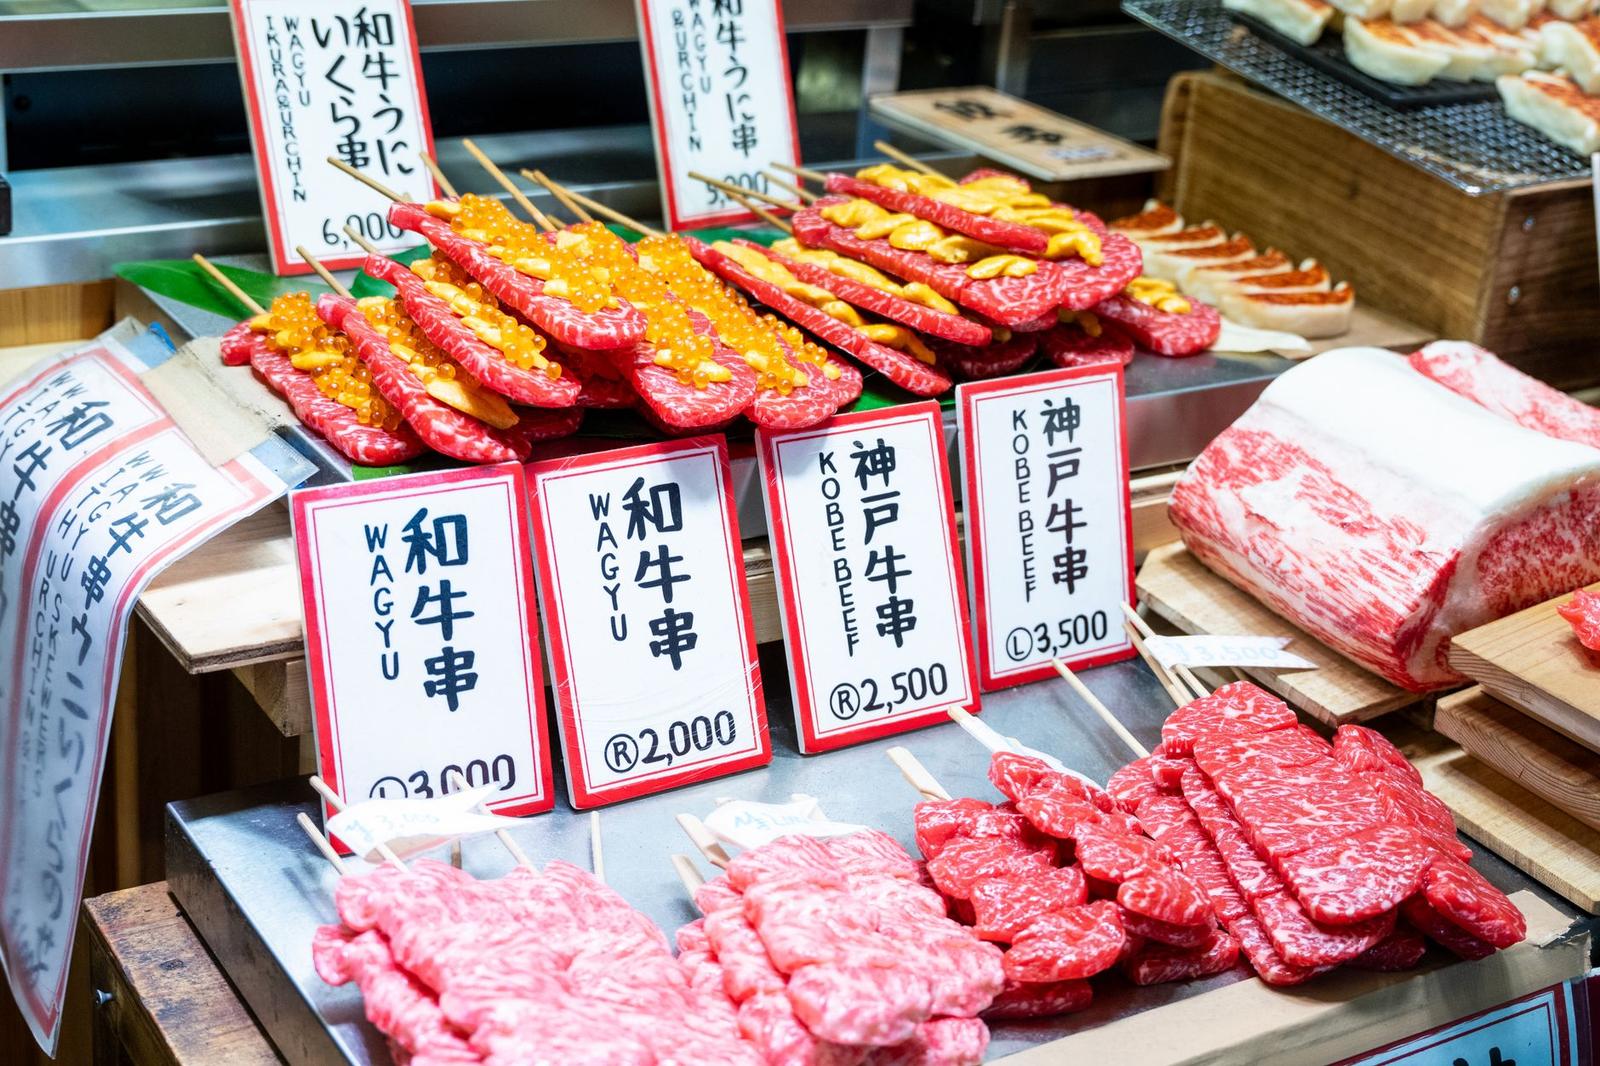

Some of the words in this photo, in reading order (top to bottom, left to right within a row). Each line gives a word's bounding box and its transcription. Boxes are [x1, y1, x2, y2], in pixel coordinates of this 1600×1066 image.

[284, 17, 310, 106] WAGYU
[311, 15, 370, 170] いくら串
[354, 7, 414, 176] 和牛うに
[1012, 409, 1031, 504] KOBE
[1040, 397, 1088, 595] 神戸牛串
[364, 523, 399, 680] WAGYU
[401, 507, 479, 712] 和牛串
[588, 492, 628, 642] WAGYU
[622, 476, 698, 671] 和牛串
[818, 451, 846, 552] KOBE
[833, 557, 860, 657] BEEF
[850, 438, 917, 648] 神戸牛串
[1018, 510, 1036, 603] BEEF
